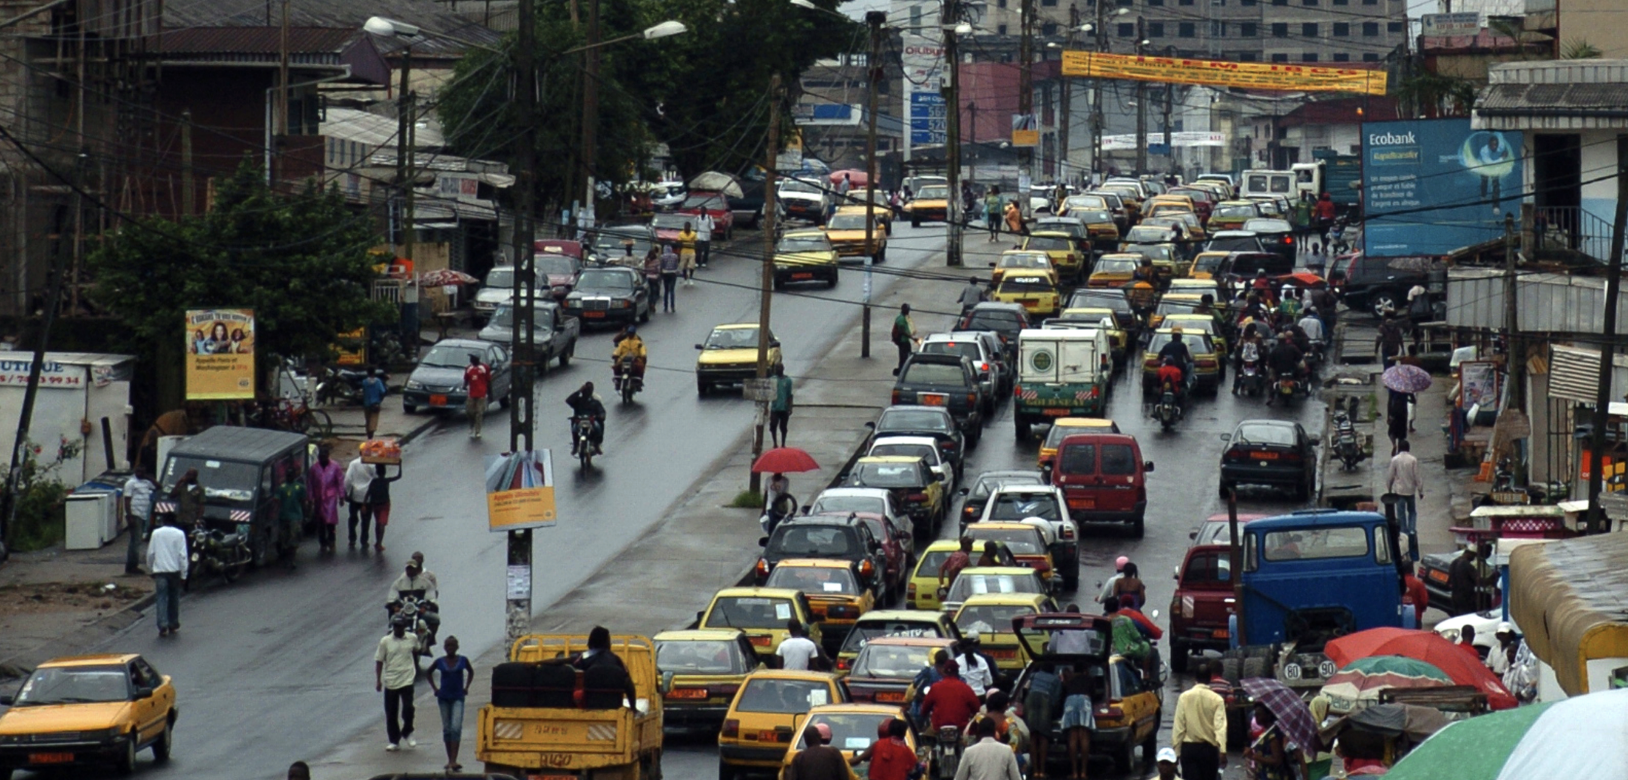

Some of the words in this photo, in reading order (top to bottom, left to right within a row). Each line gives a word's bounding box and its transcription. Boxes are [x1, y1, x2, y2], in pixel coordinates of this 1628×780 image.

[1369, 132, 1415, 145] Ecobank
[0, 361, 64, 373] UTIUE
[1287, 665, 1299, 678] 80
[1321, 663, 1334, 675] 90
